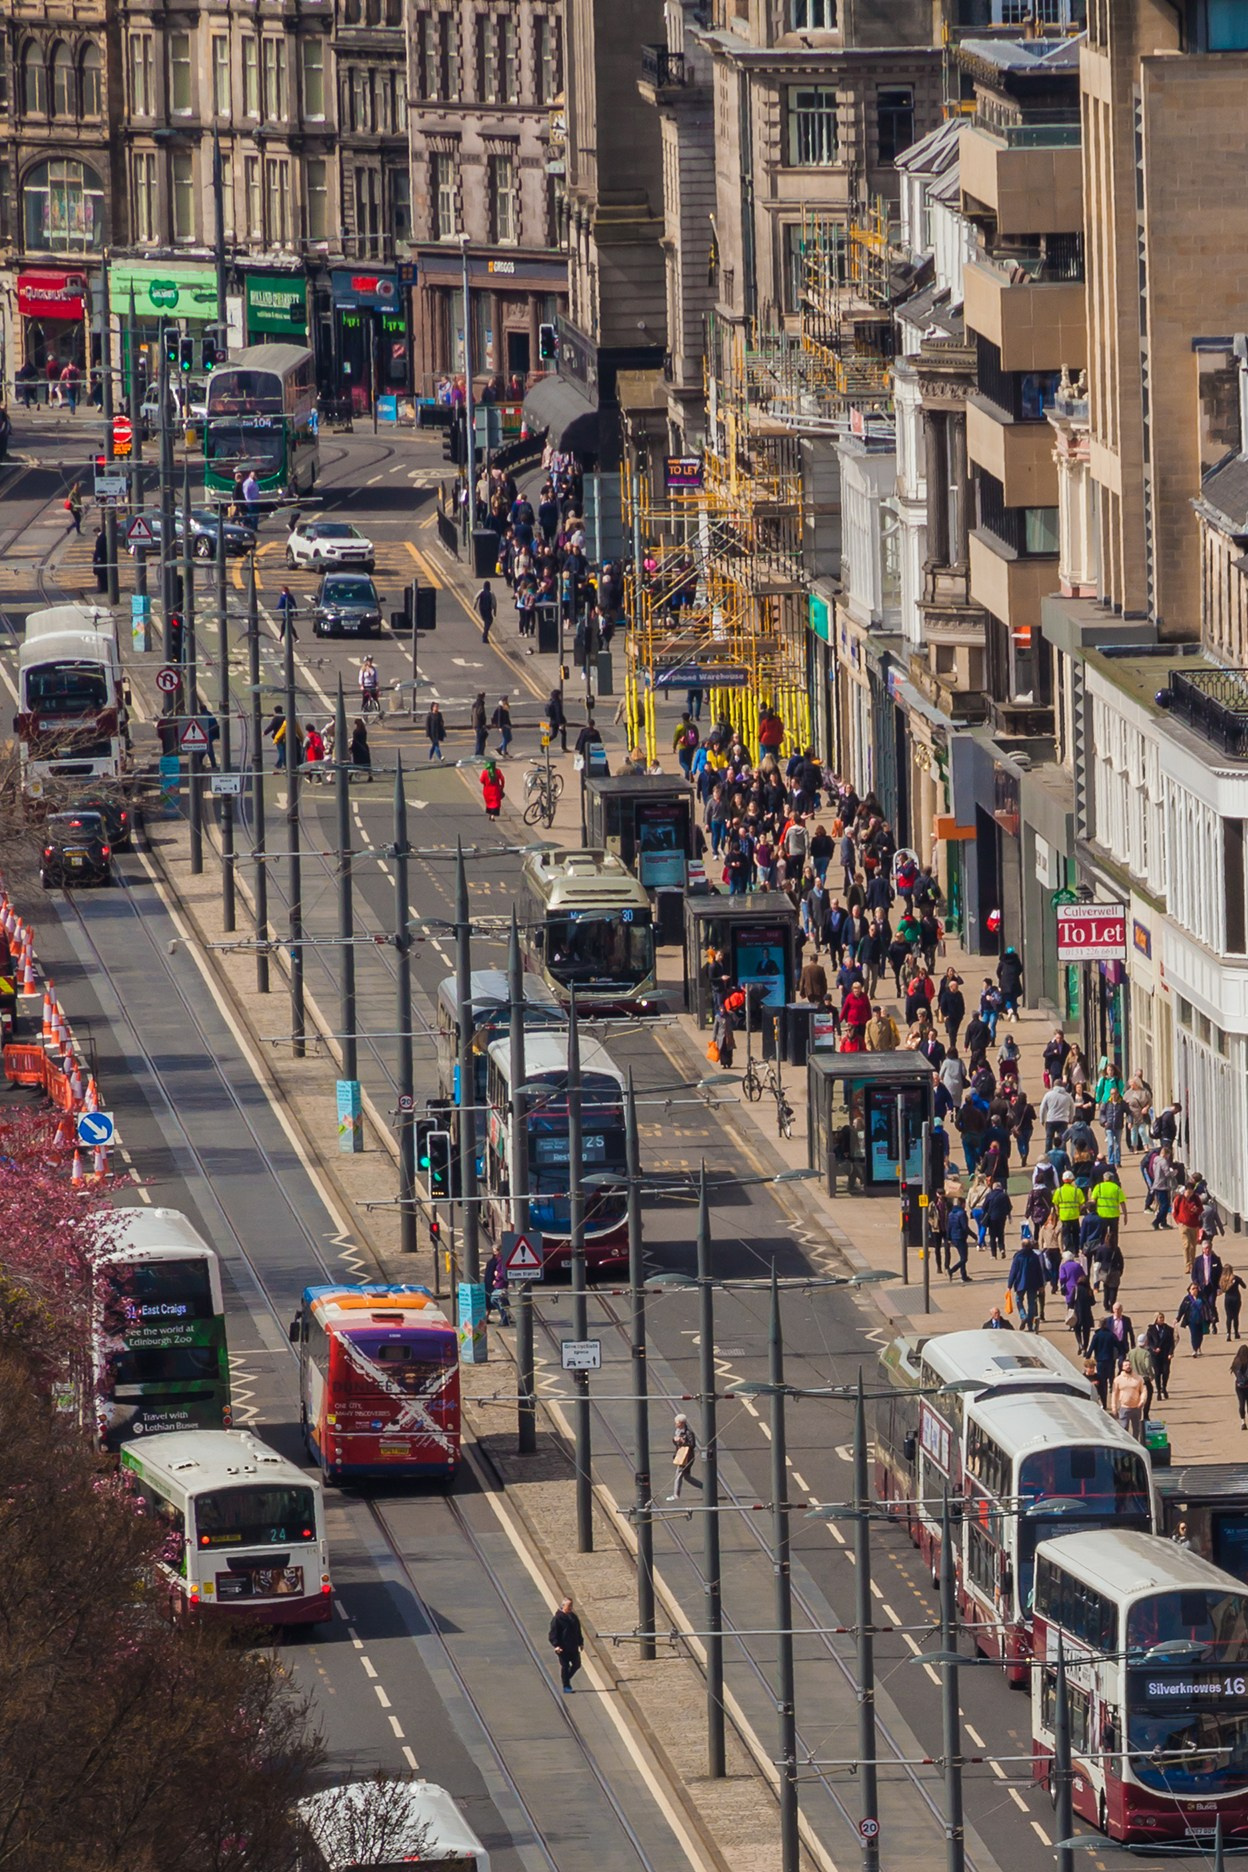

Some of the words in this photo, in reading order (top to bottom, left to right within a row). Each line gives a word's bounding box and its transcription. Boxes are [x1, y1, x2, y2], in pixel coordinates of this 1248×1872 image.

[669, 465, 682, 475] TO
[684, 465, 698, 475] LET
[622, 909, 634, 921] 30
[1063, 906, 1118, 917] Culverwell
[1058, 922, 1086, 943] To
[1090, 922, 1125, 943] Let
[585, 1135, 605, 1148] 25
[141, 1305, 160, 1316] East
[160, 1303, 187, 1316] Craigs
[143, 1326, 158, 1335] the
[160, 1324, 184, 1334] world
[185, 1324, 195, 1333] at
[129, 1336, 172, 1347] Edinburgh
[174, 1335, 192, 1344] Zoo
[142, 1412, 168, 1422] Travel
[169, 1410, 189, 1420] with
[144, 1421, 175, 1432] Lothian
[176, 1420, 199, 1430] Buses
[270, 1527, 286, 1542] 24
[1148, 1682, 1222, 1695] Silverknowes
[1224, 1677, 1246, 1695] 16
[863, 1823, 877, 1833] 20
